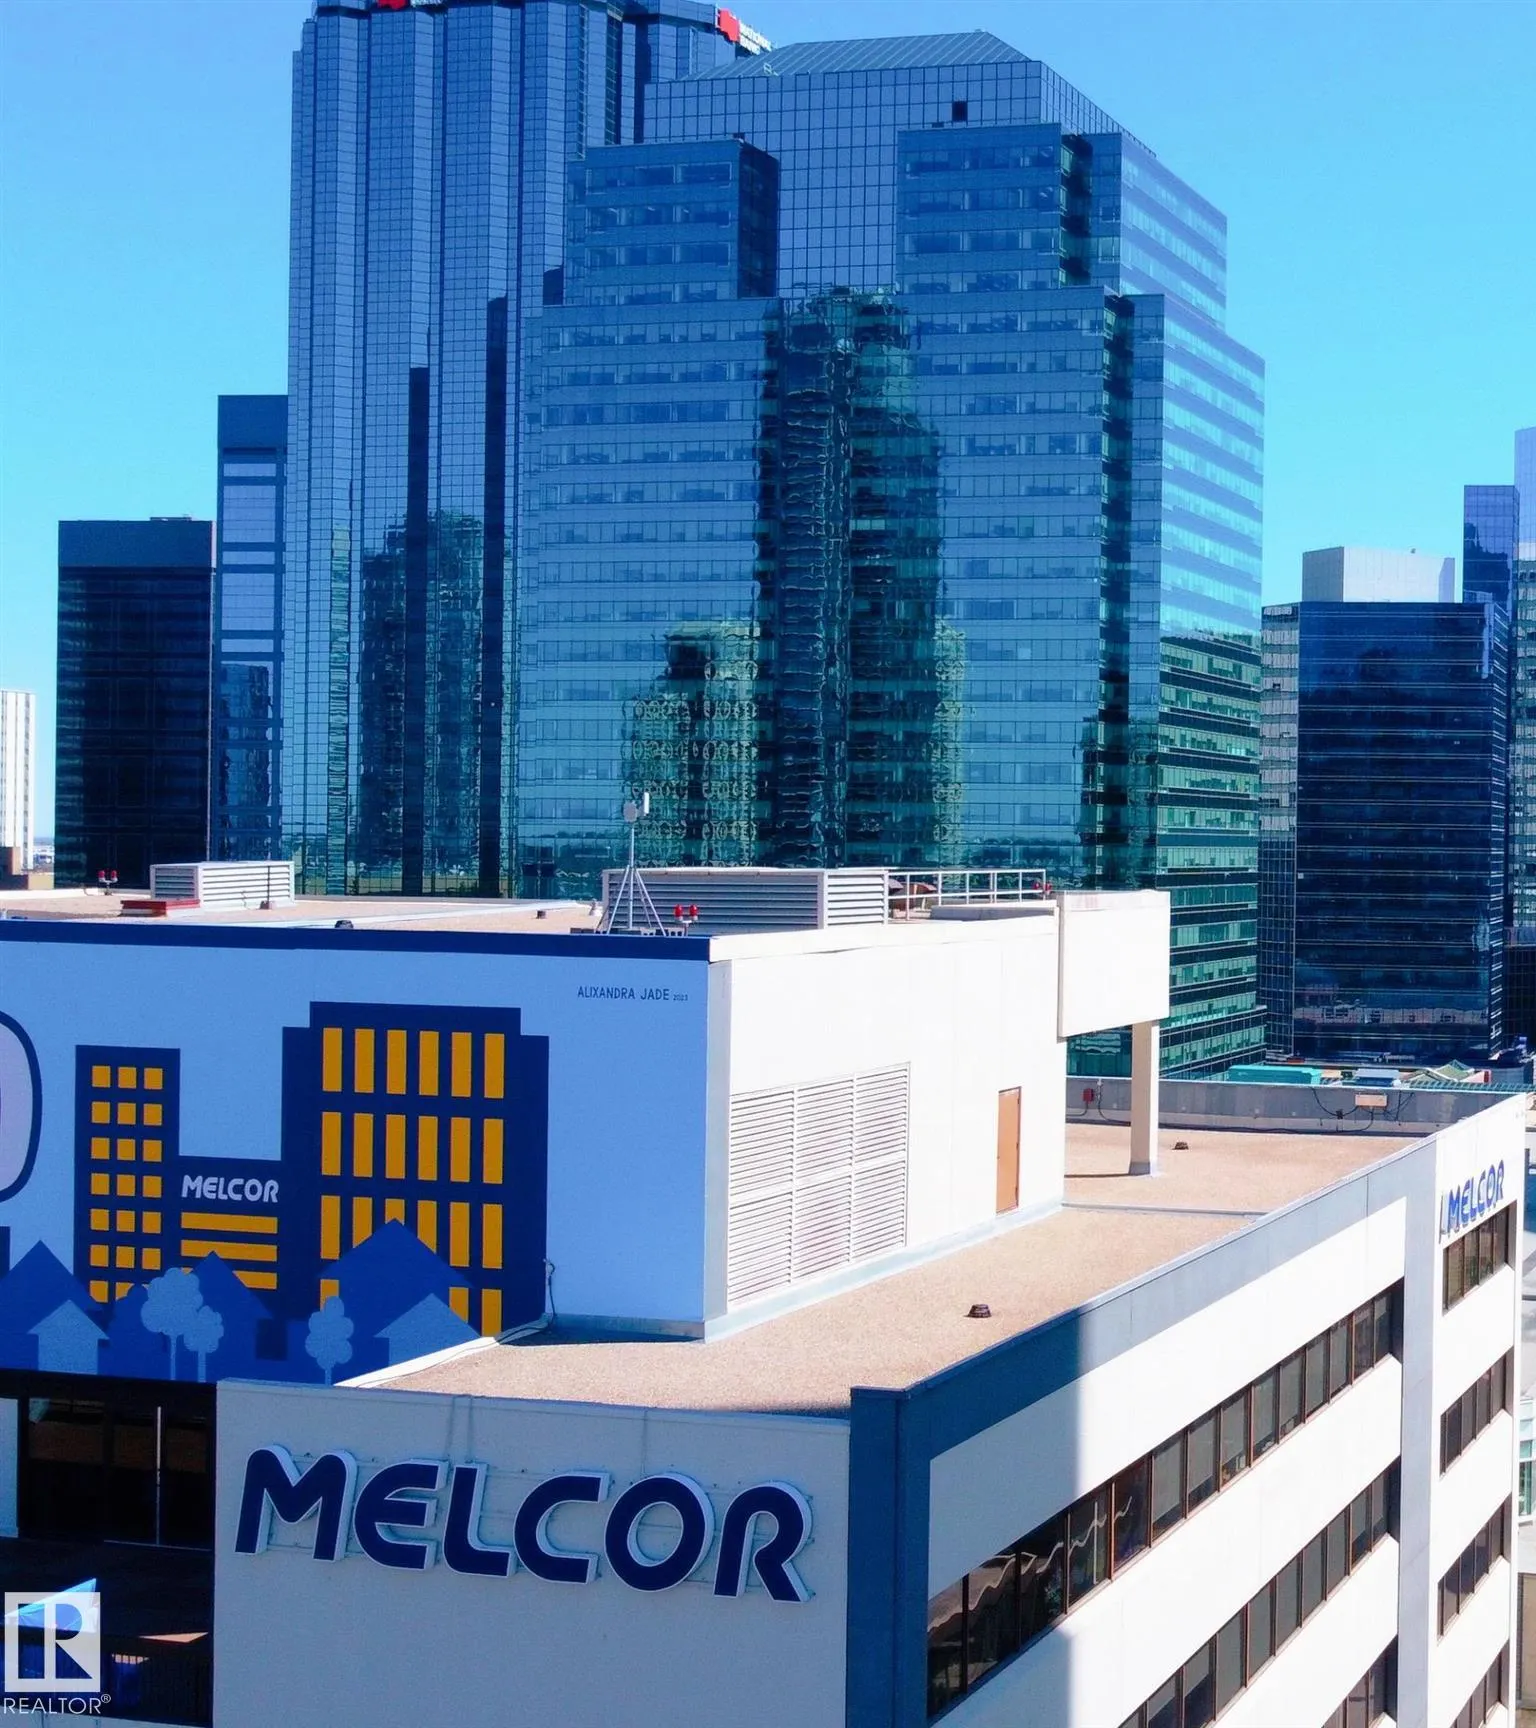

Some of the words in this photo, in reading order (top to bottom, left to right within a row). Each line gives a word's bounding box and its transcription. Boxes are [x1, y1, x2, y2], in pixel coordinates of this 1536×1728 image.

[577, 986, 636, 999] ALIXANDRA
[640, 988, 670, 1000] JADE
[182, 1174, 279, 1203] MELCOR
[1447, 1160, 1504, 1235] MELCOR
[234, 1446, 811, 1603] MELCOR
